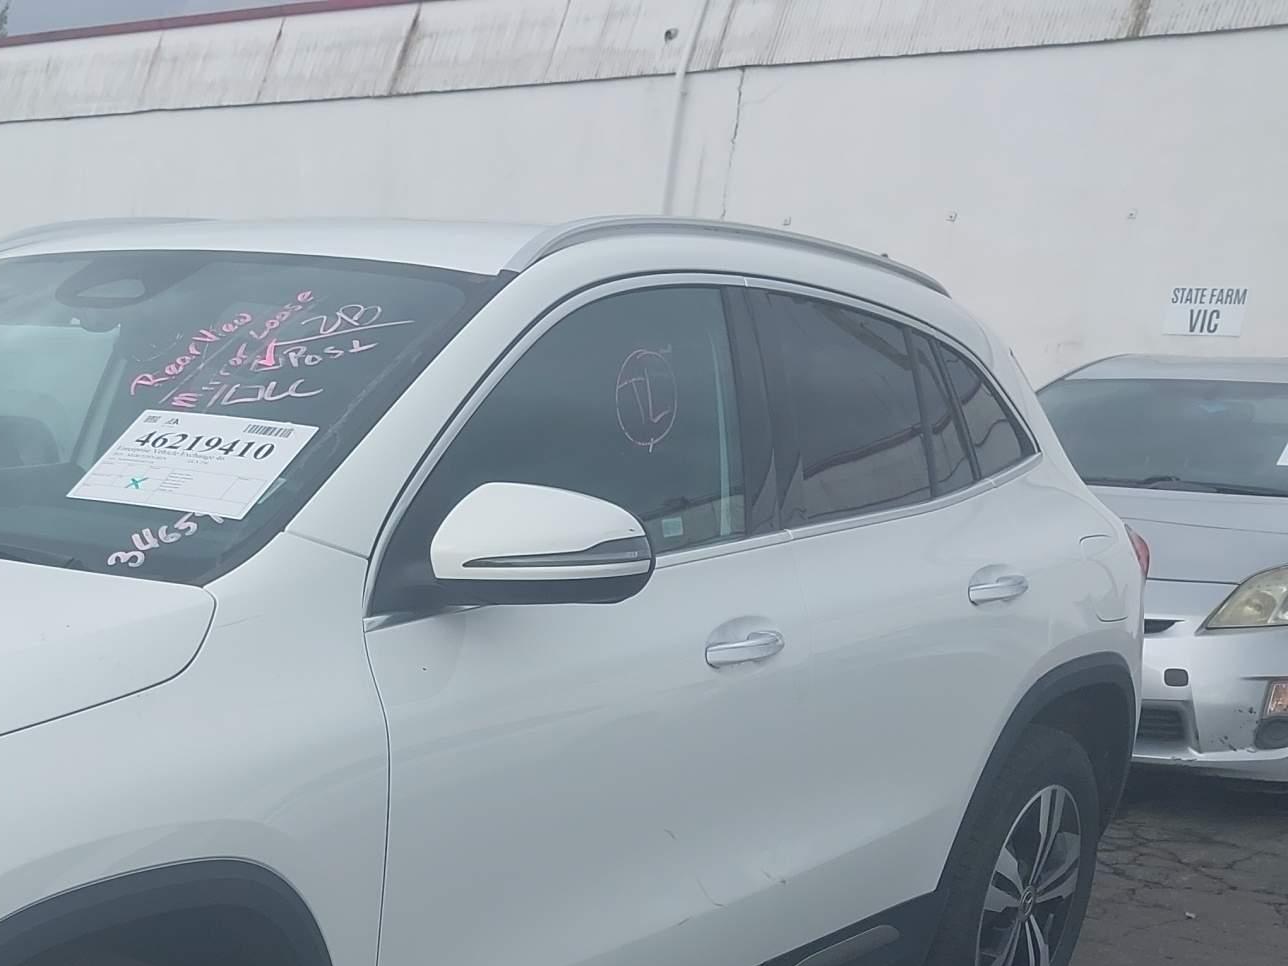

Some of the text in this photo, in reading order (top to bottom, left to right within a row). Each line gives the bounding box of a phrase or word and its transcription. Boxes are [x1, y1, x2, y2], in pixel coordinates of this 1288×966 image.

[1171, 287, 1248, 305] STATE FARM
[1189, 309, 1220, 333] VIC
[135, 431, 275, 461] 46219410
